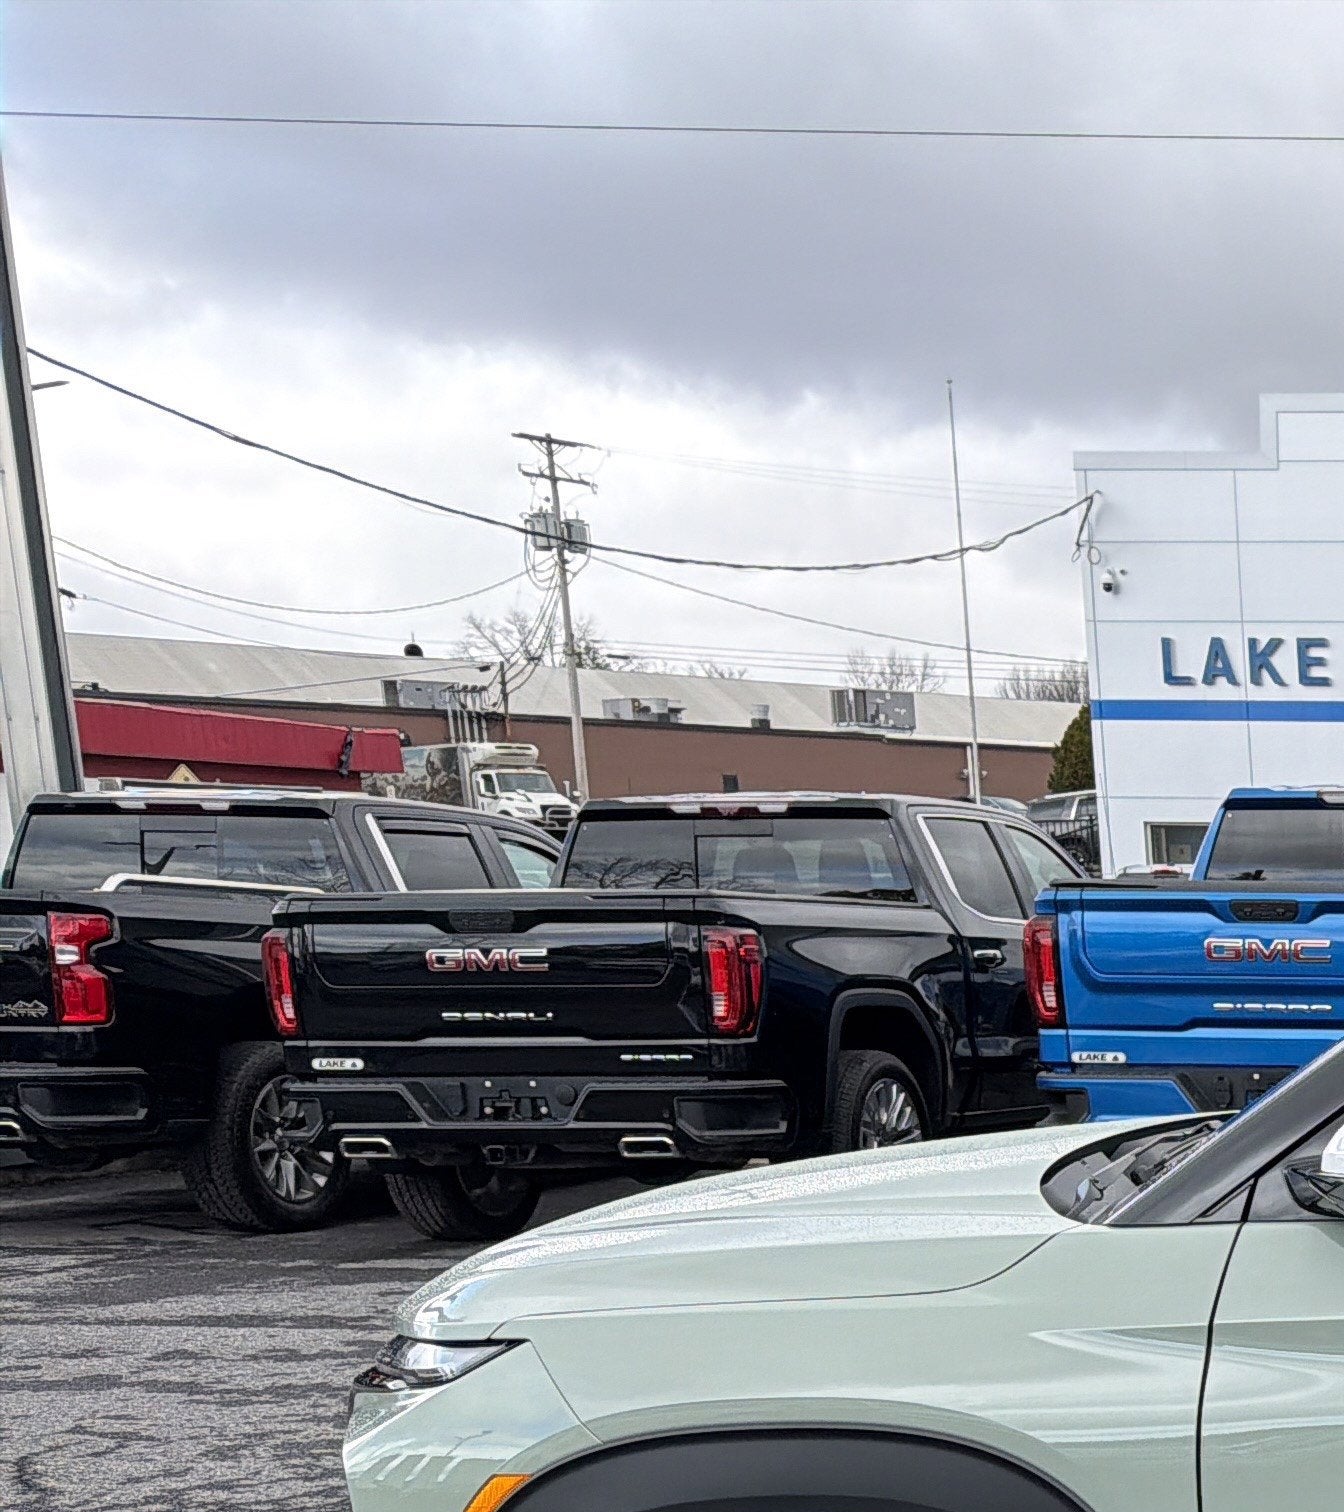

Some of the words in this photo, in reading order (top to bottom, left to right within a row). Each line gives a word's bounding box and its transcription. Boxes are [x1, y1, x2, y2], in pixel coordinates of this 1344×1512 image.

[1160, 636, 1333, 687] LAKE
[1204, 938, 1332, 963] GMC
[426, 948, 549, 971] GMC
[441, 1011, 553, 1020] DENALI
[318, 1060, 346, 1068] LAKE
[1079, 1053, 1107, 1061] LAKE
